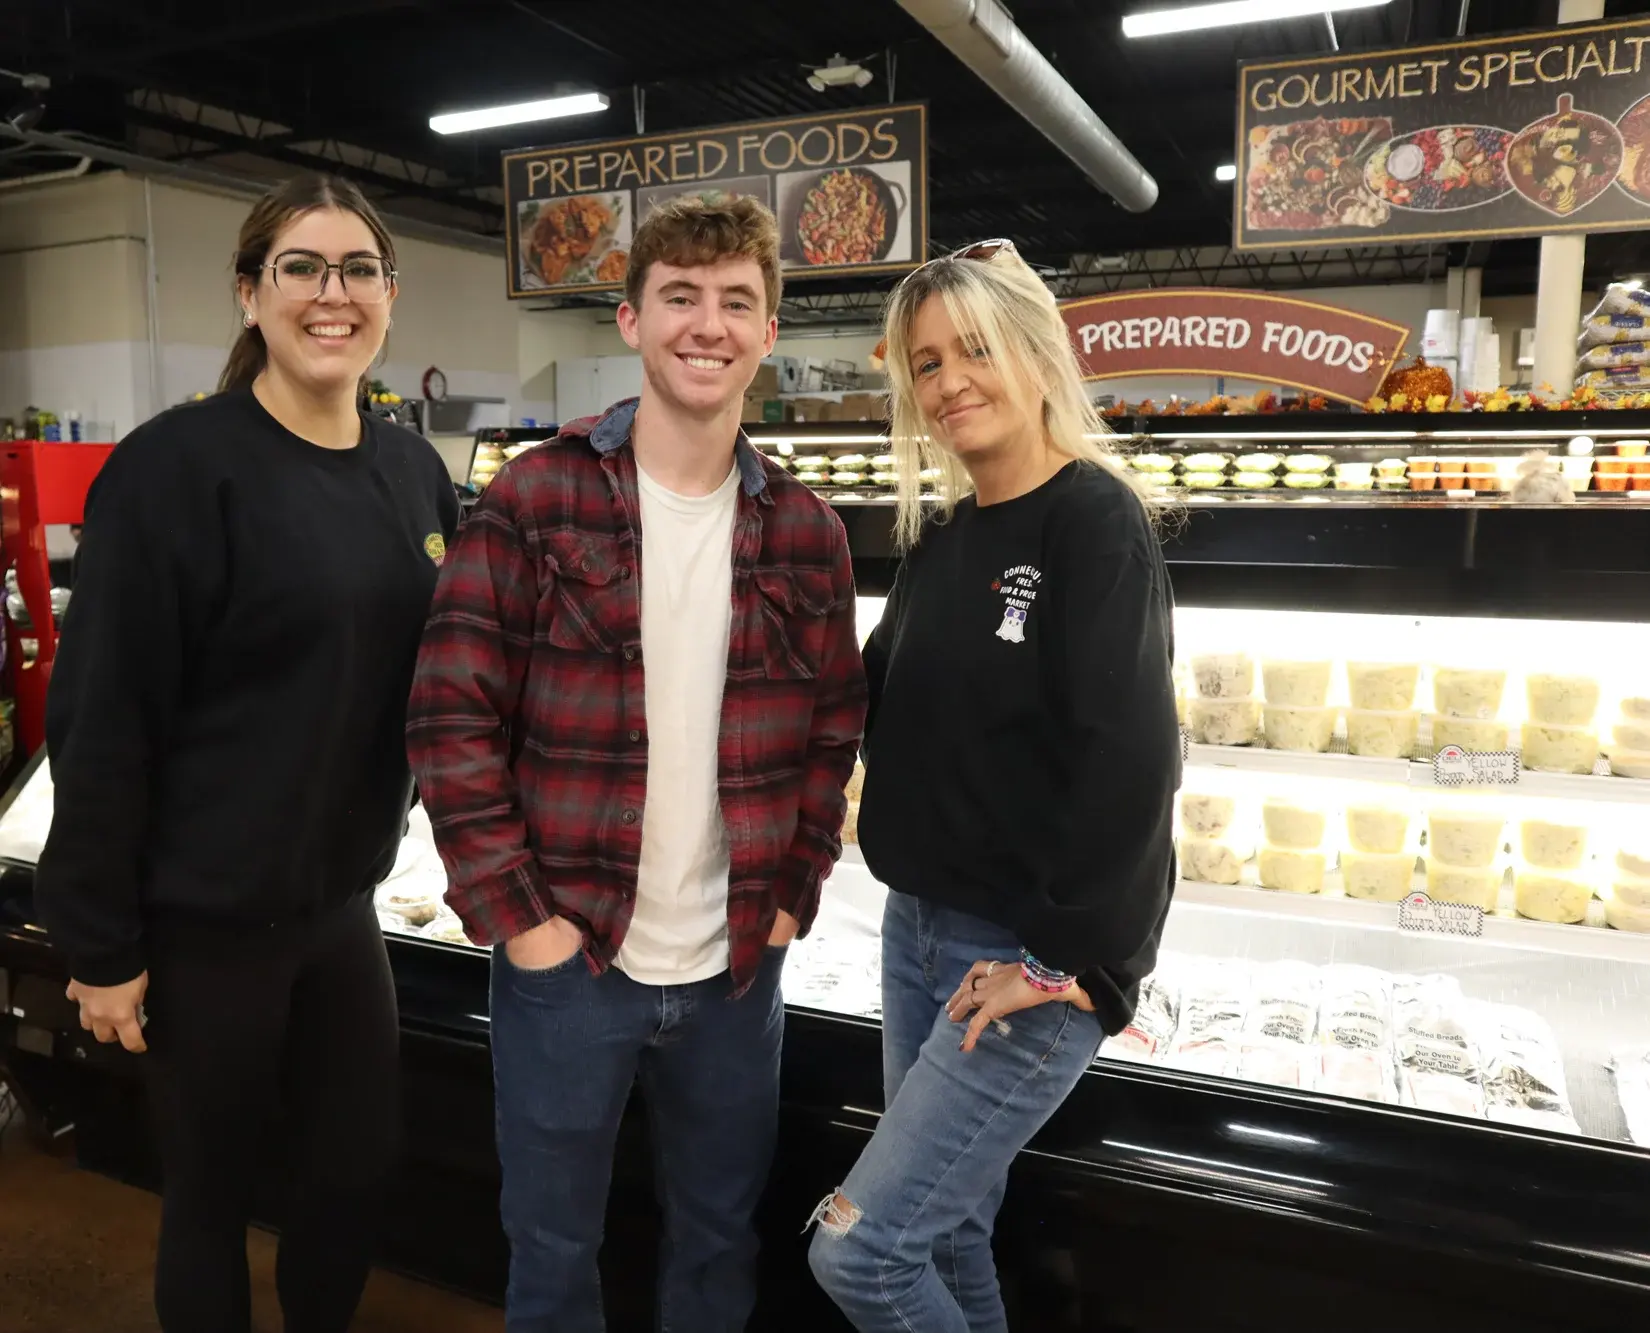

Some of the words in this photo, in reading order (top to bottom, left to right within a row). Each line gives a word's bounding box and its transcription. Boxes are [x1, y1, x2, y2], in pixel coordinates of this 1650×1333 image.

[1251, 59, 1449, 112] GOURMET
[527, 140, 728, 196] PREPARED
[738, 118, 899, 173] FOODS
[1078, 316, 1251, 355] PREPARED
[1261, 321, 1374, 373] FOODS
[1016, 577, 1033, 588] FRES
[1005, 597, 1030, 610] MARKET
[1465, 757, 1507, 768] YELLOW
[1408, 1026, 1434, 1039] Stuffed
[1436, 1033, 1463, 1041] Breads
[1431, 1052, 1451, 1060] Oven
[1417, 1059, 1436, 1067] Your
[1438, 1061, 1459, 1070] Table
